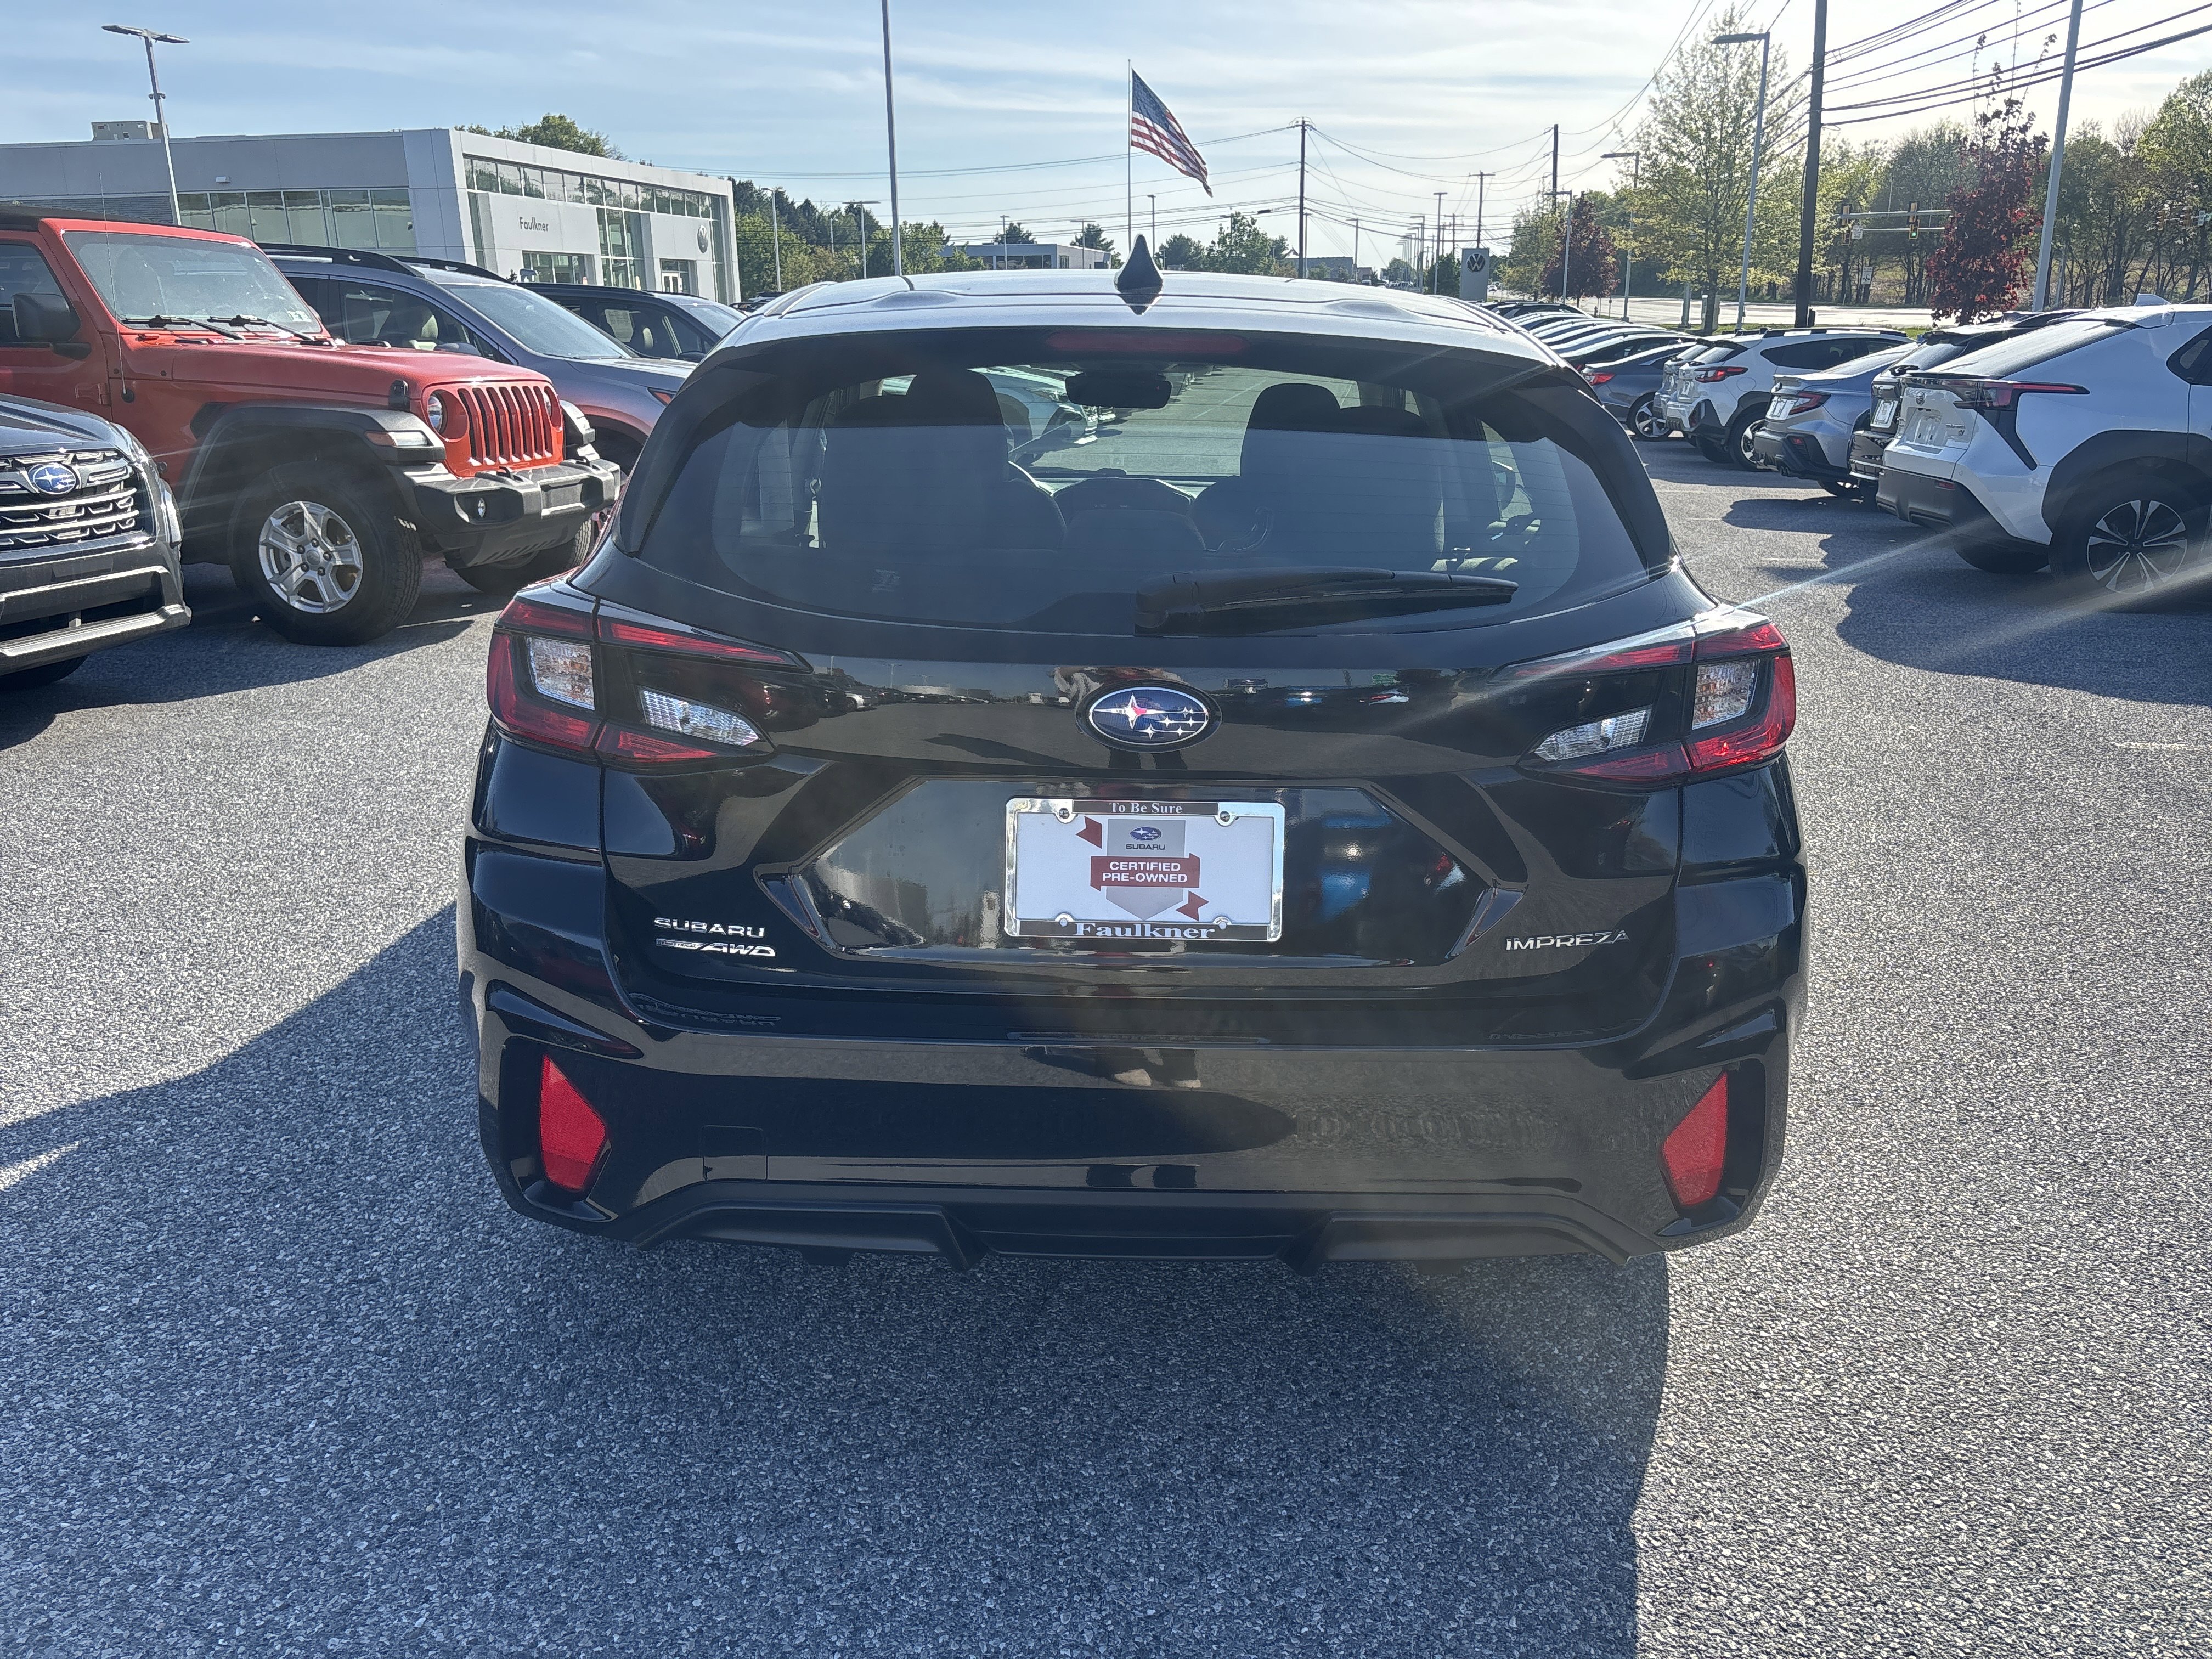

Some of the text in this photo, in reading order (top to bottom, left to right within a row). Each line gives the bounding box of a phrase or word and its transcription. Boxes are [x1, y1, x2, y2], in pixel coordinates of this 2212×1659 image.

[519, 216, 549, 232] Faulkner
[1466, 253, 1486, 273] VW
[1109, 802, 1182, 814] To Be Sure
[1109, 861, 1181, 871] CERTIFIED
[1102, 872, 1188, 883] PRE-OWNED
[654, 917, 765, 939] SUBARU
[1073, 922, 1216, 939] Faulkner
[1506, 930, 1630, 950] IMPREZA
[700, 943, 776, 957] AWD
